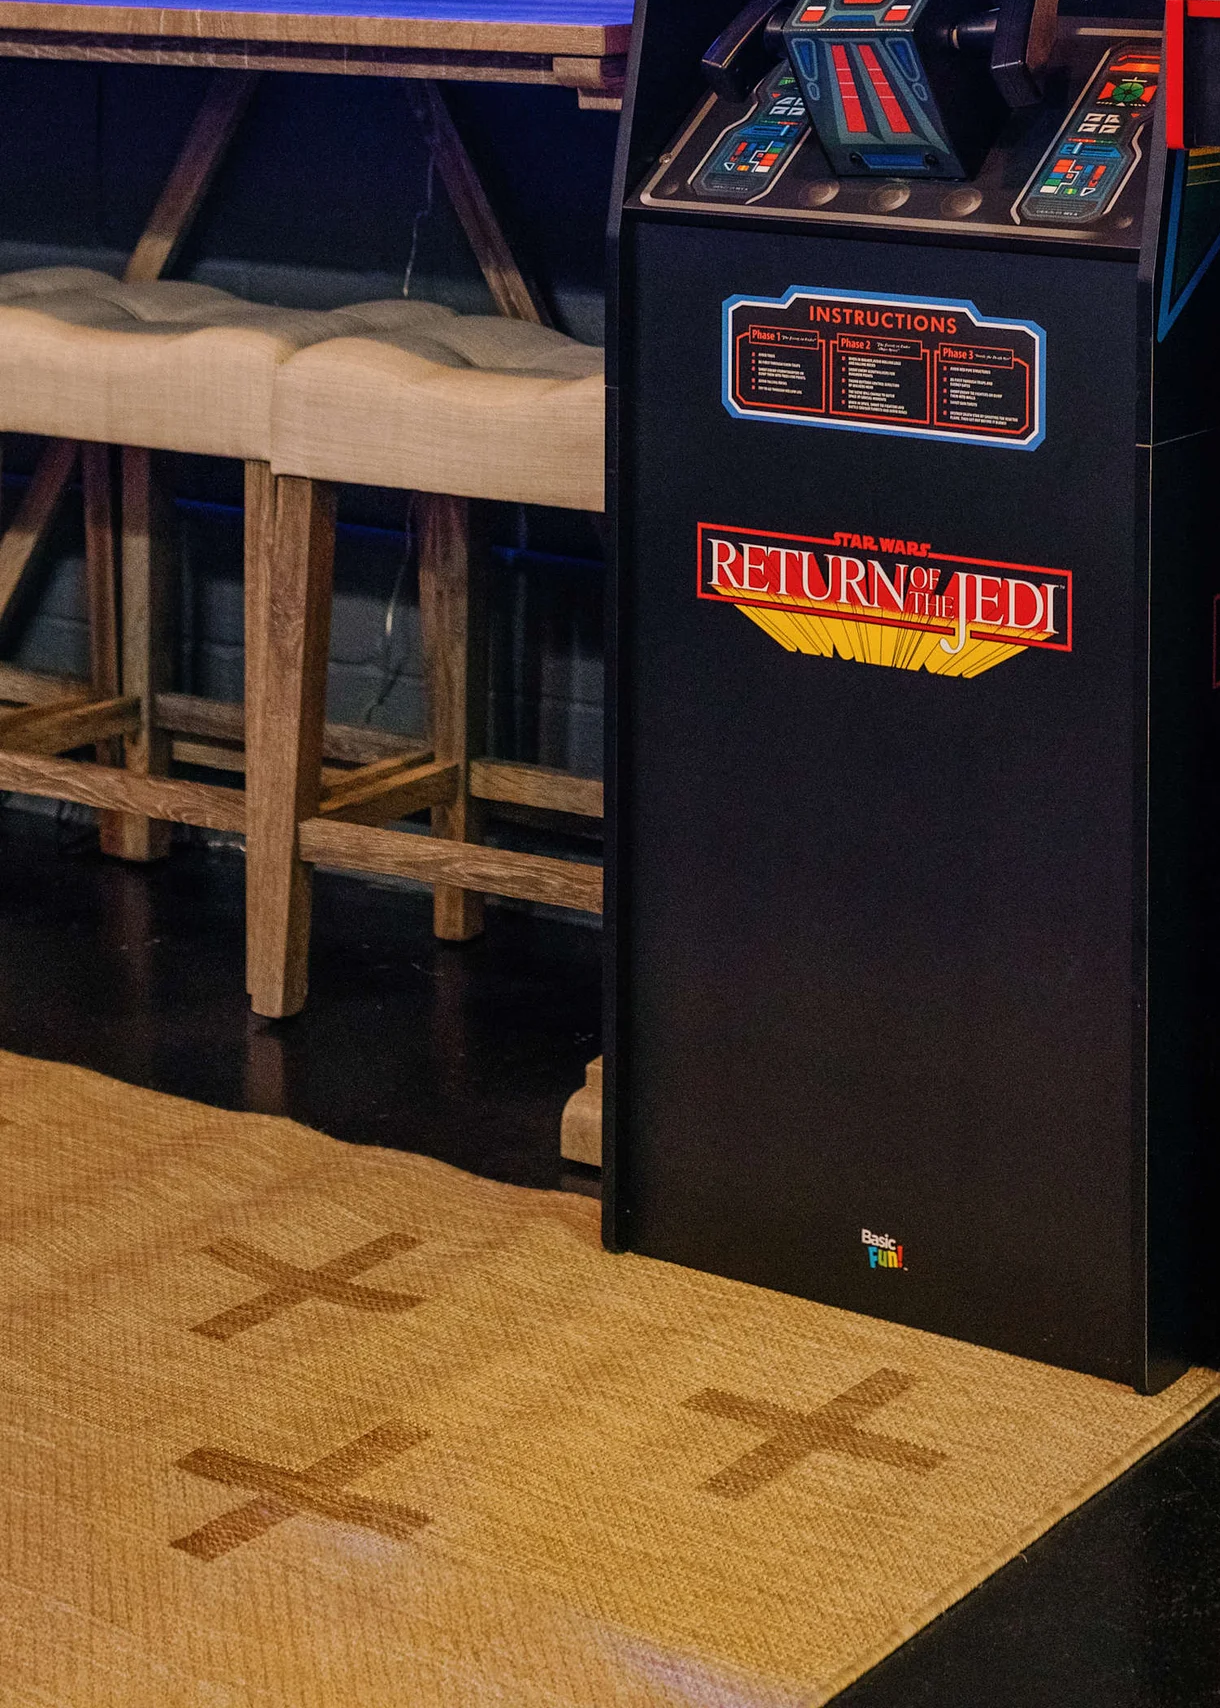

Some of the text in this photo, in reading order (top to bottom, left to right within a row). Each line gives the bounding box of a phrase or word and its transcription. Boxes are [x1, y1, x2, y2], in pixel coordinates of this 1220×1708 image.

[808, 304, 958, 335] INSTRUCTIONS
[751, 329, 776, 341] Phase
[776, 332, 781, 342] 1
[841, 337, 865, 349] Phase
[865, 340, 871, 350] 2
[943, 347, 967, 359] Phase
[968, 350, 974, 360] 3
[833, 532, 932, 558] STAR WARS
[707, 538, 908, 611] RETURN
[909, 565, 941, 590] OF
[909, 591, 955, 620] THE
[940, 571, 1060, 654] JEDI
[861, 1228, 897, 1251] Basic
[867, 1245, 904, 1269] Fun!
